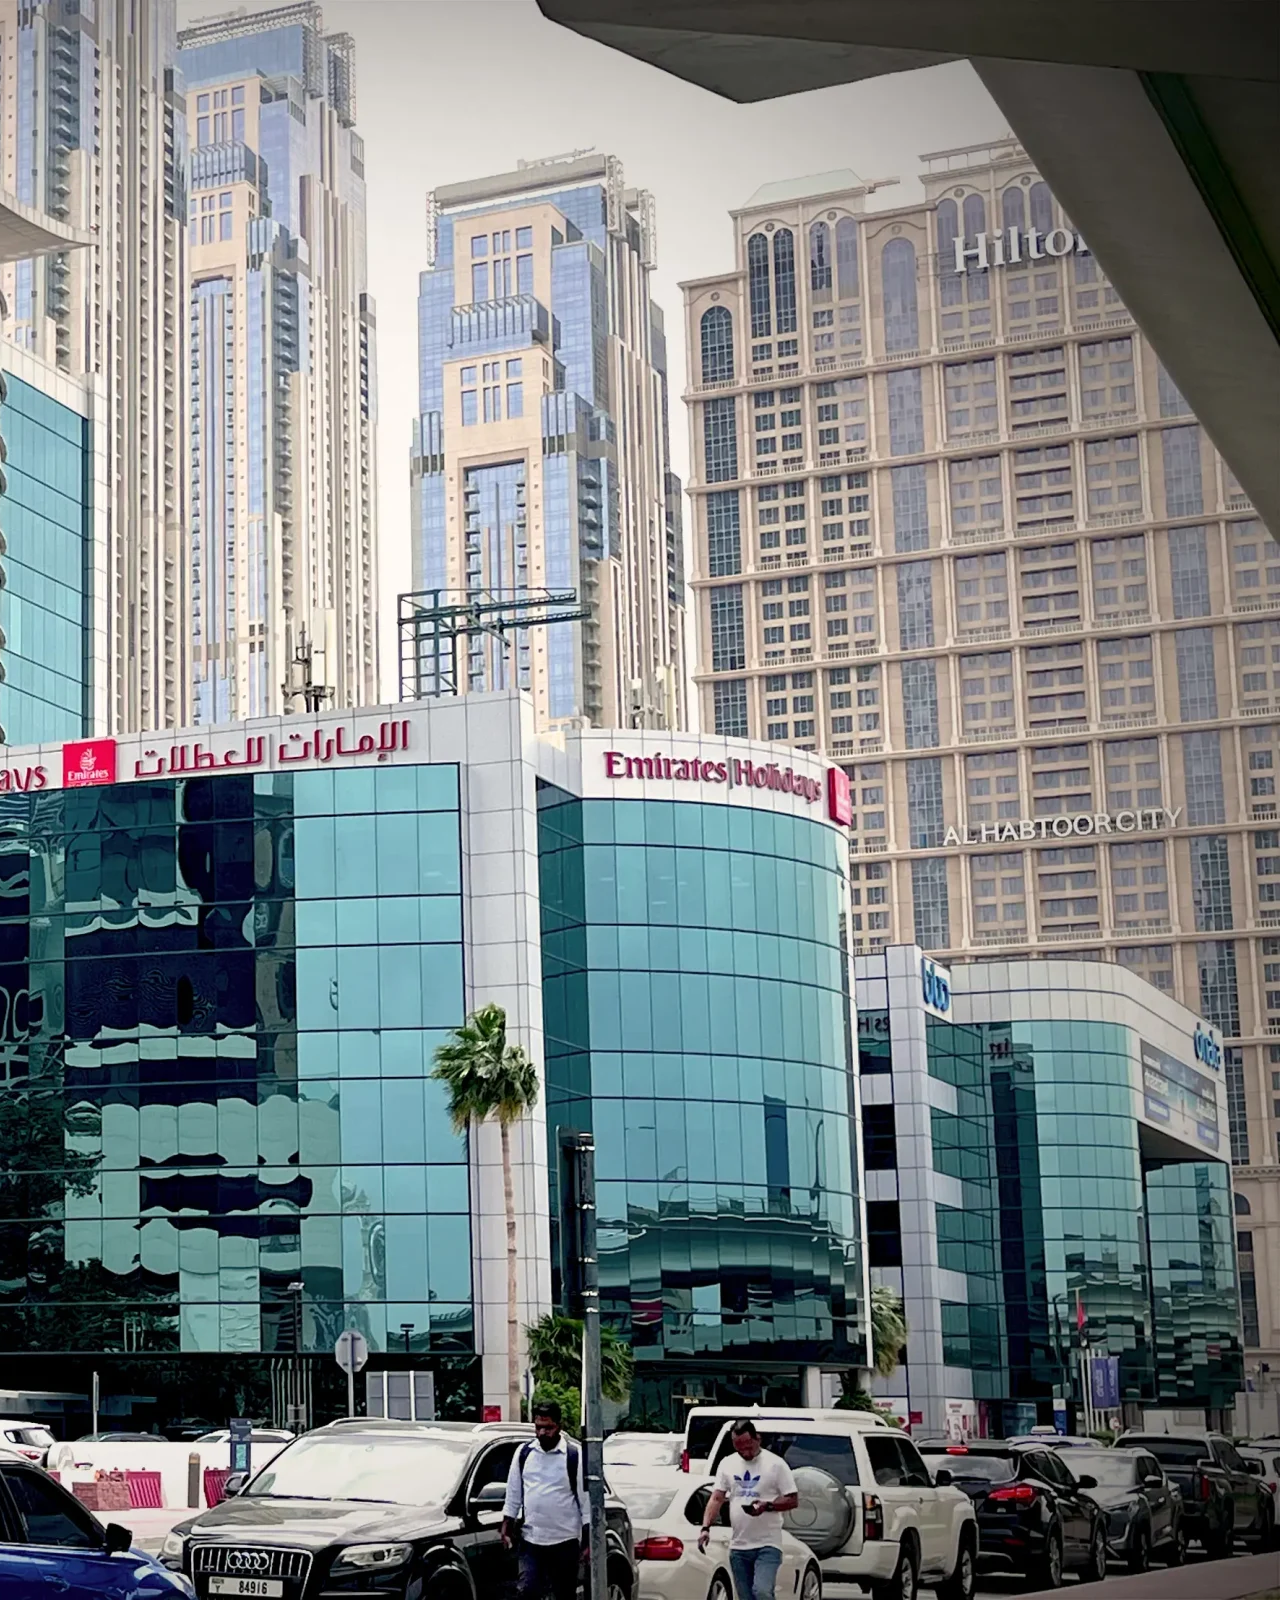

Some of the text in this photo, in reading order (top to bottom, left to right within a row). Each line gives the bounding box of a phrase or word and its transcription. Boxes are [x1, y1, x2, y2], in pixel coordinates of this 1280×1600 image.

[67, 769, 109, 781] Emirates
[604, 751, 822, 804] Emirates Holidays
[943, 806, 1182, 847] AL HABTOOR CITY
[238, 1580, 268, 1595] 84916
